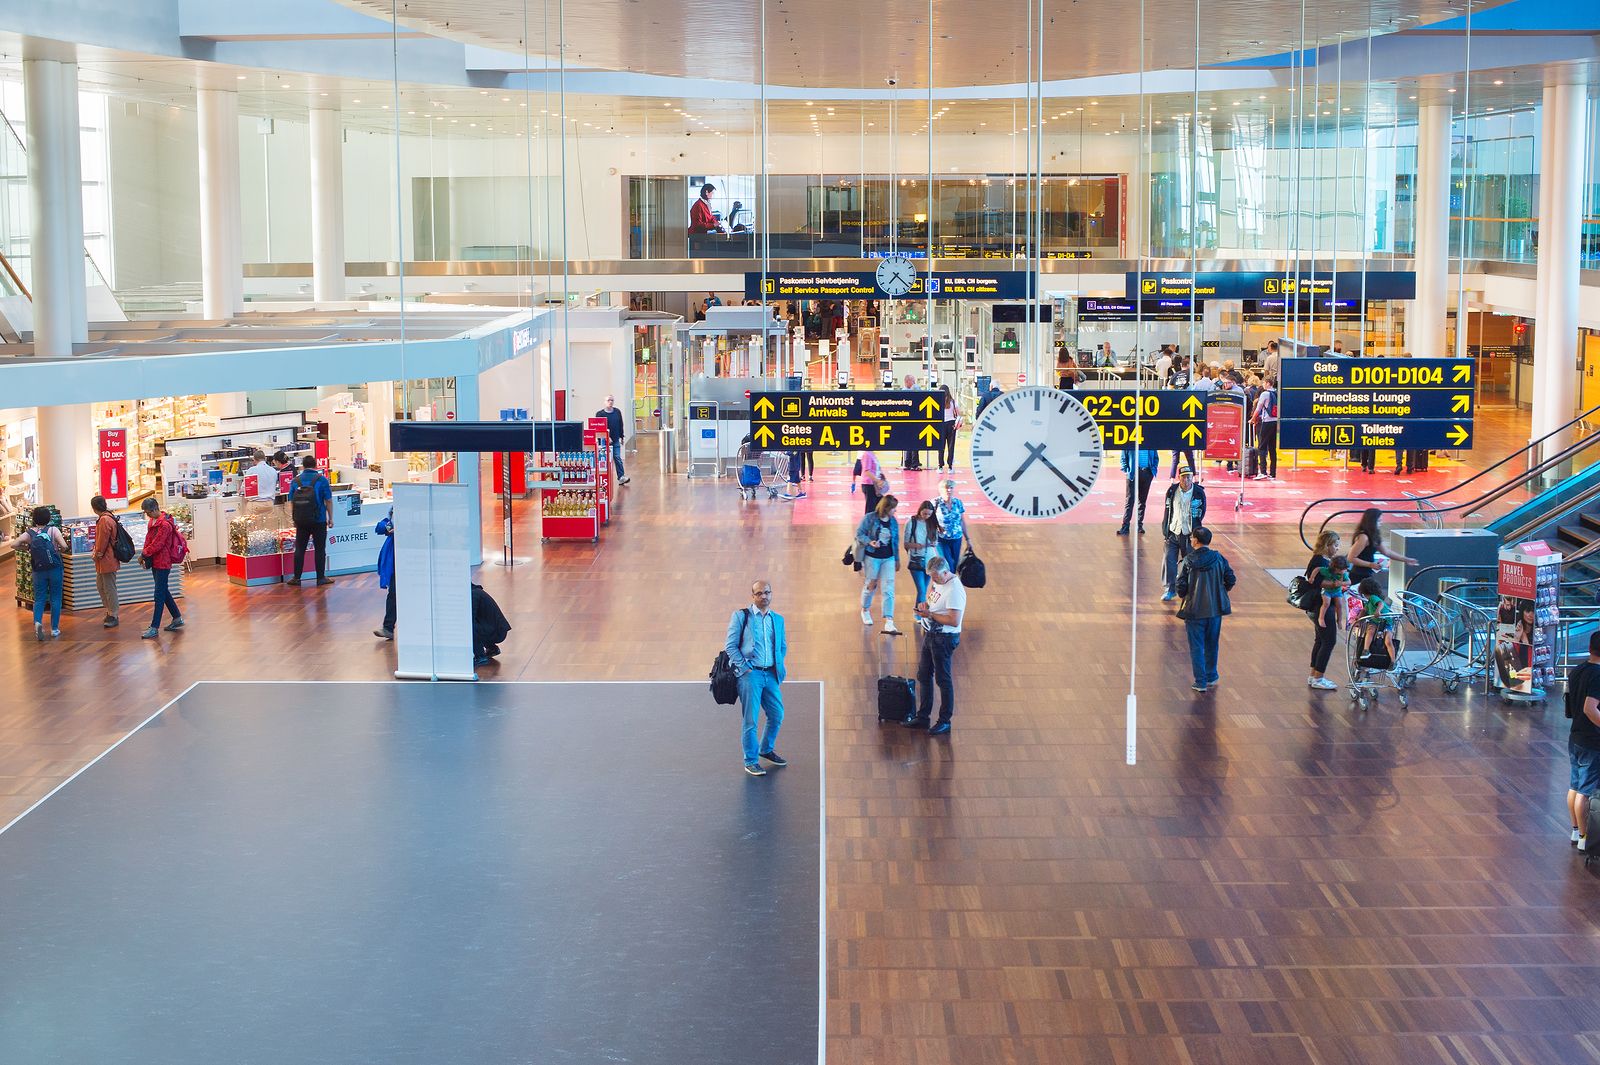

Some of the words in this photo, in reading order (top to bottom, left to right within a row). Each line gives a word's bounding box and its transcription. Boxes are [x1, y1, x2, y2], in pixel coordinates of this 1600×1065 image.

[779, 277, 814, 285] Paskontrol
[815, 277, 860, 286] Selvbetjening
[1161, 277, 1193, 285] Paskontro
[820, 287, 849, 295] Passport
[1161, 287, 1191, 295] Passport
[1313, 362, 1338, 372] Gate
[1313, 374, 1344, 385] Gates
[1350, 367, 1444, 385] D101-D104
[808, 395, 854, 406] Ankomst
[1312, 392, 1370, 402] Primeclass
[1372, 392, 1411, 404] Lounge
[1082, 395, 1160, 417] C2-C10
[1312, 404, 1370, 415] Primeclass
[1372, 404, 1411, 416] Lounge
[808, 407, 848, 417] Arrivals
[781, 425, 812, 435] Gates
[1361, 424, 1404, 434] Toiletter
[781, 435, 813, 446] Gates
[819, 426, 841, 448] A,
[849, 426, 871, 448] B,
[879, 426, 892, 446] F
[1361, 436, 1395, 446] Toilets
[335, 534, 350, 543] TAX
[350, 532, 368, 541] FREE
[1503, 564, 1524, 577] TRAVEL
[1503, 574, 1533, 588] PRODUCTS
